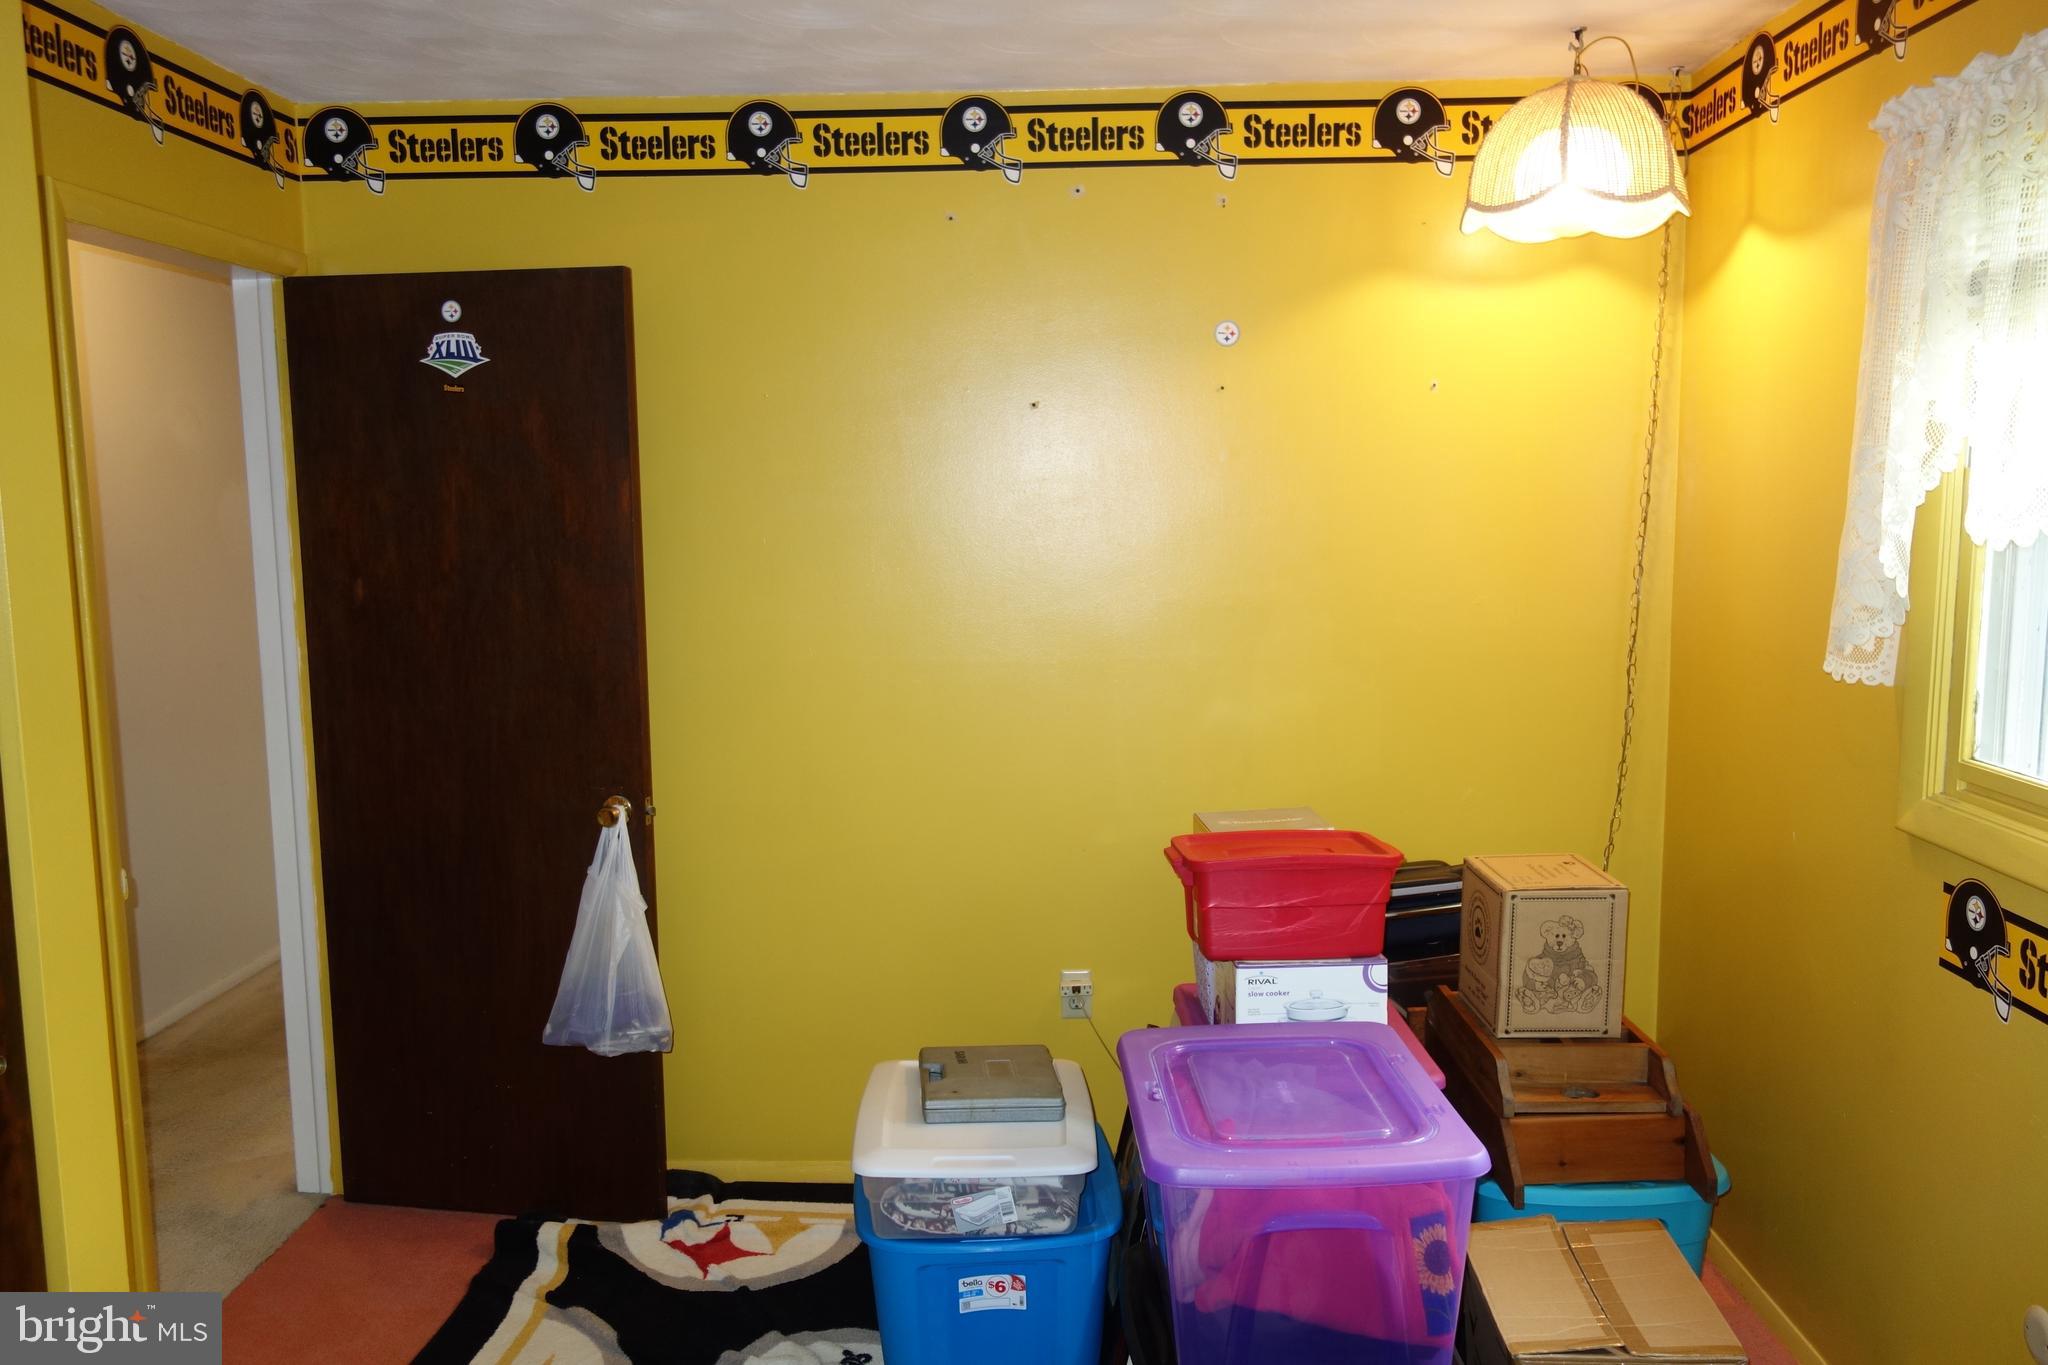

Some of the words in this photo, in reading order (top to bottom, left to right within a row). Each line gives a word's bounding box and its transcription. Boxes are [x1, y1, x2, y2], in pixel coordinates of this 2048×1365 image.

[1681, 86, 1736, 139] Steelers
[1784, 18, 1849, 82] Steelers
[163, 74, 235, 140] Steelers
[388, 128, 504, 164] Steelers
[600, 125, 716, 161] Steelers
[812, 122, 930, 159] Steelers
[1027, 117, 1145, 153] Steelers
[1243, 113, 1362, 150] Steelers
[430, 339, 480, 363] XLIII
[1247, 978, 1278, 986] RIVAL
[1247, 990, 1264, 998] slow
[988, 1280, 1007, 1293] $6
